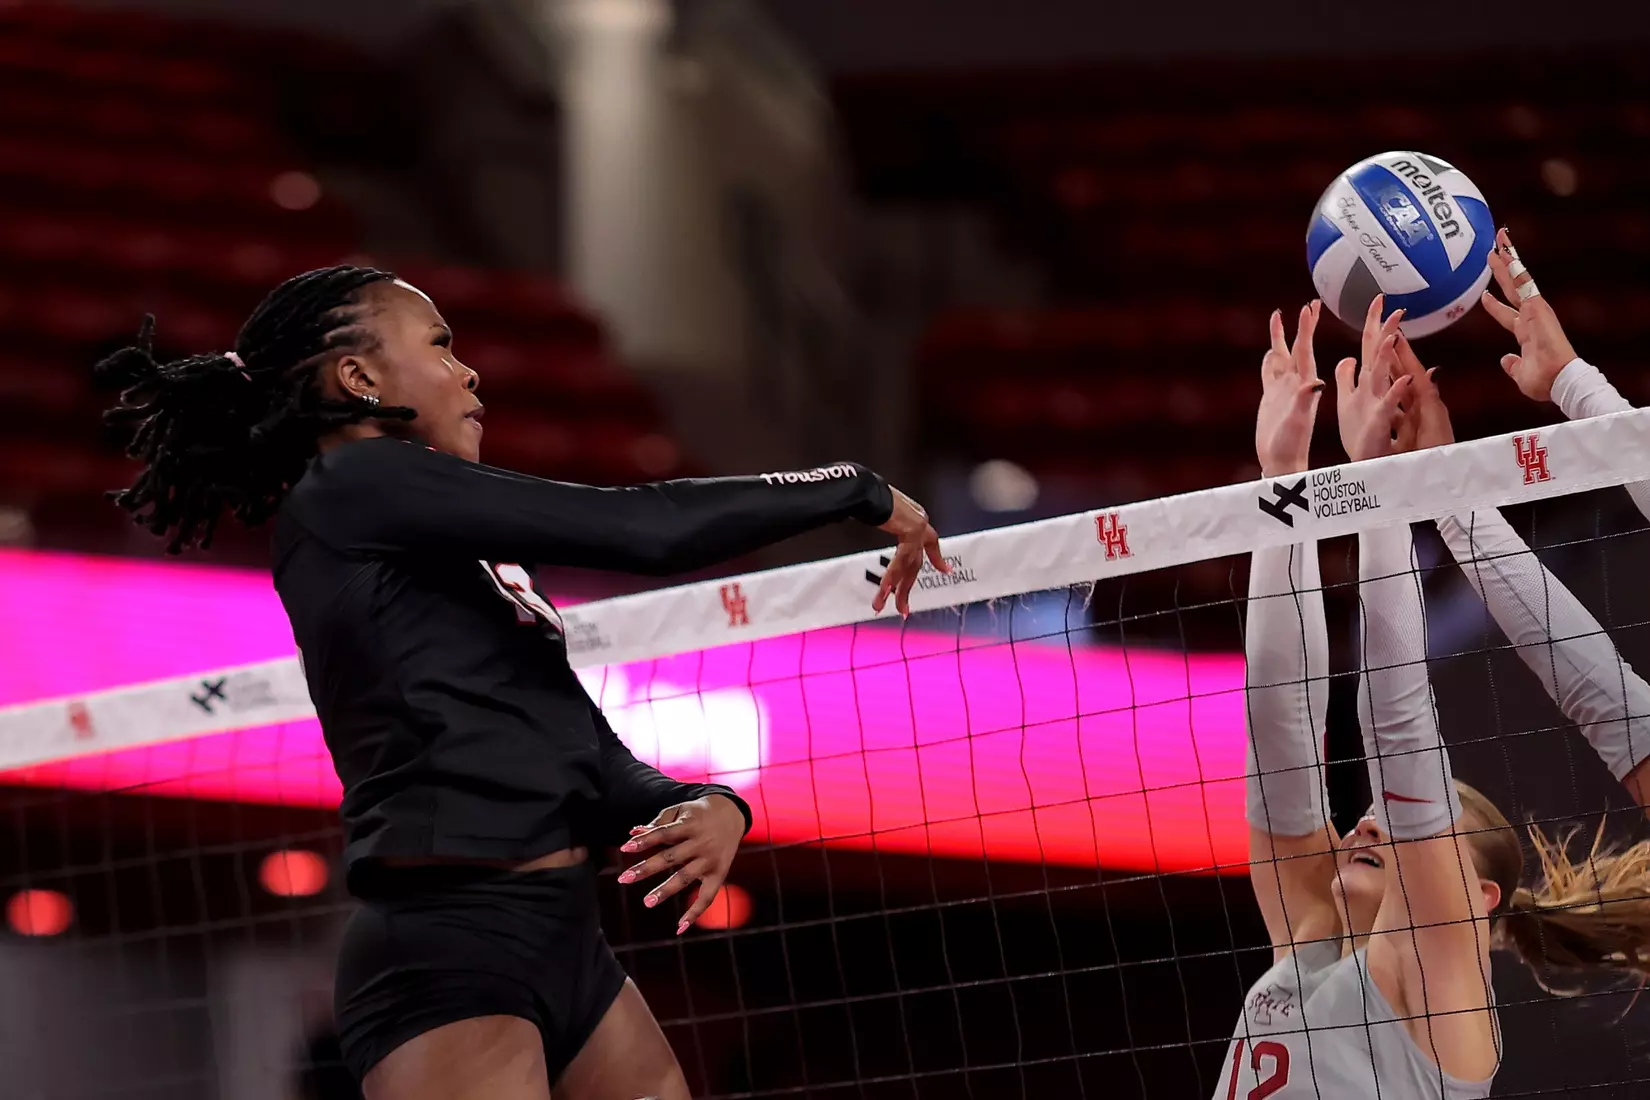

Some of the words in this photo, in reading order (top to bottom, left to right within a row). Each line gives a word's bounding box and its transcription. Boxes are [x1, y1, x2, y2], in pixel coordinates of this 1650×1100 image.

[1391, 160, 1461, 239] molten
[1359, 232, 1399, 273] Touch
[1312, 469, 1341, 487] LOVB
[1314, 480, 1366, 503] HOUSTON
[1314, 495, 1381, 518] VOLLEYBALL
[1227, 1039, 1290, 1100] 12
